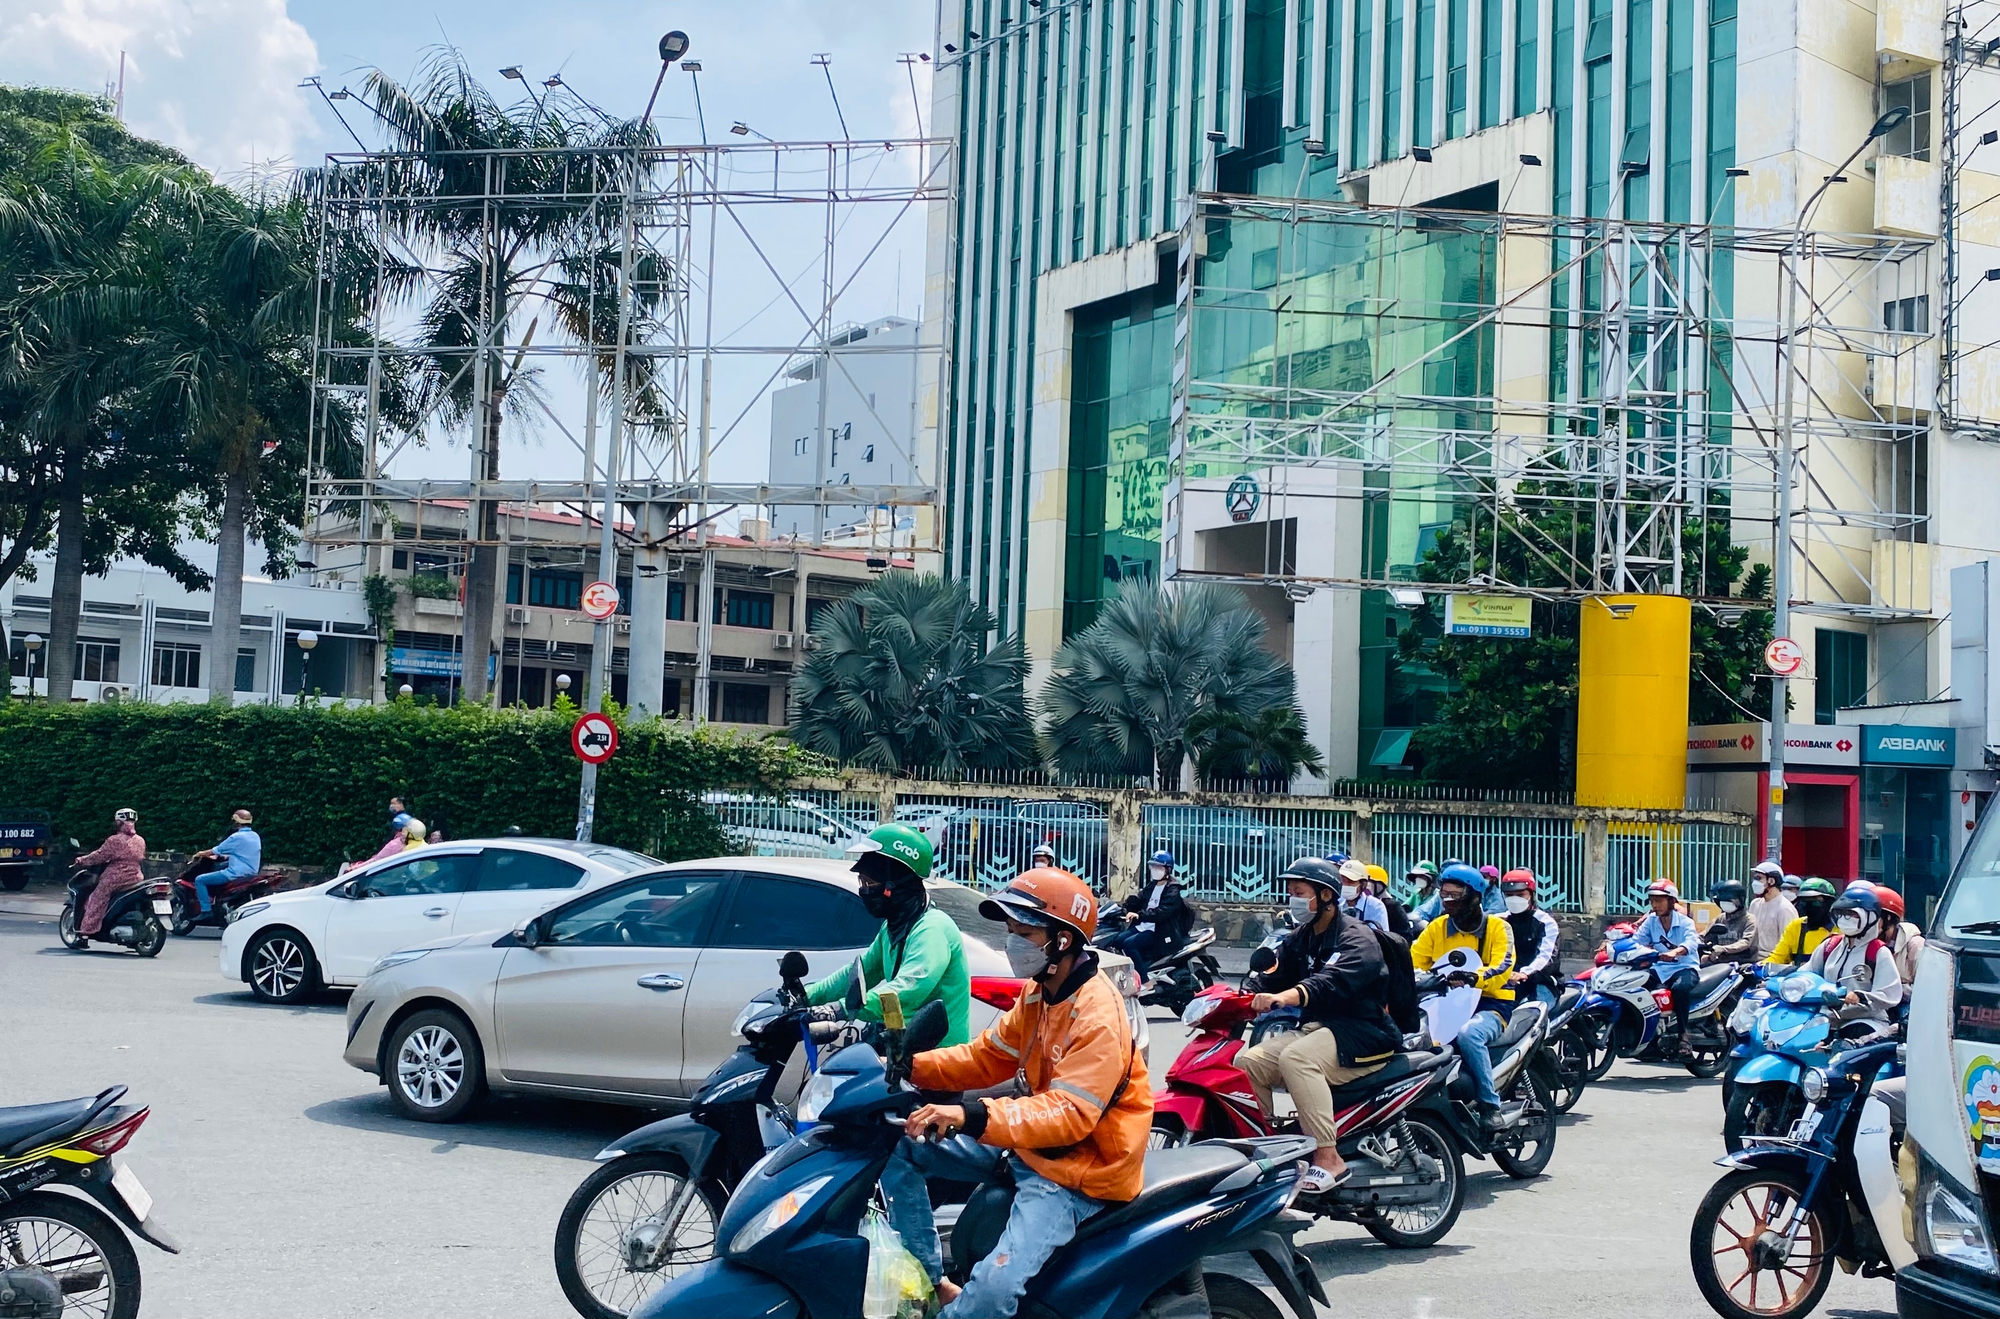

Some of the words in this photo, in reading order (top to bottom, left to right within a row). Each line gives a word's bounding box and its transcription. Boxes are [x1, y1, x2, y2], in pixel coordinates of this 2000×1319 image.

[1468, 626, 1489, 634] 0911
[1491, 627, 1503, 635] 39
[1504, 628, 1525, 636] 5555
[1878, 737, 1946, 752] ABBANK
[892, 840, 920, 860] Grab
